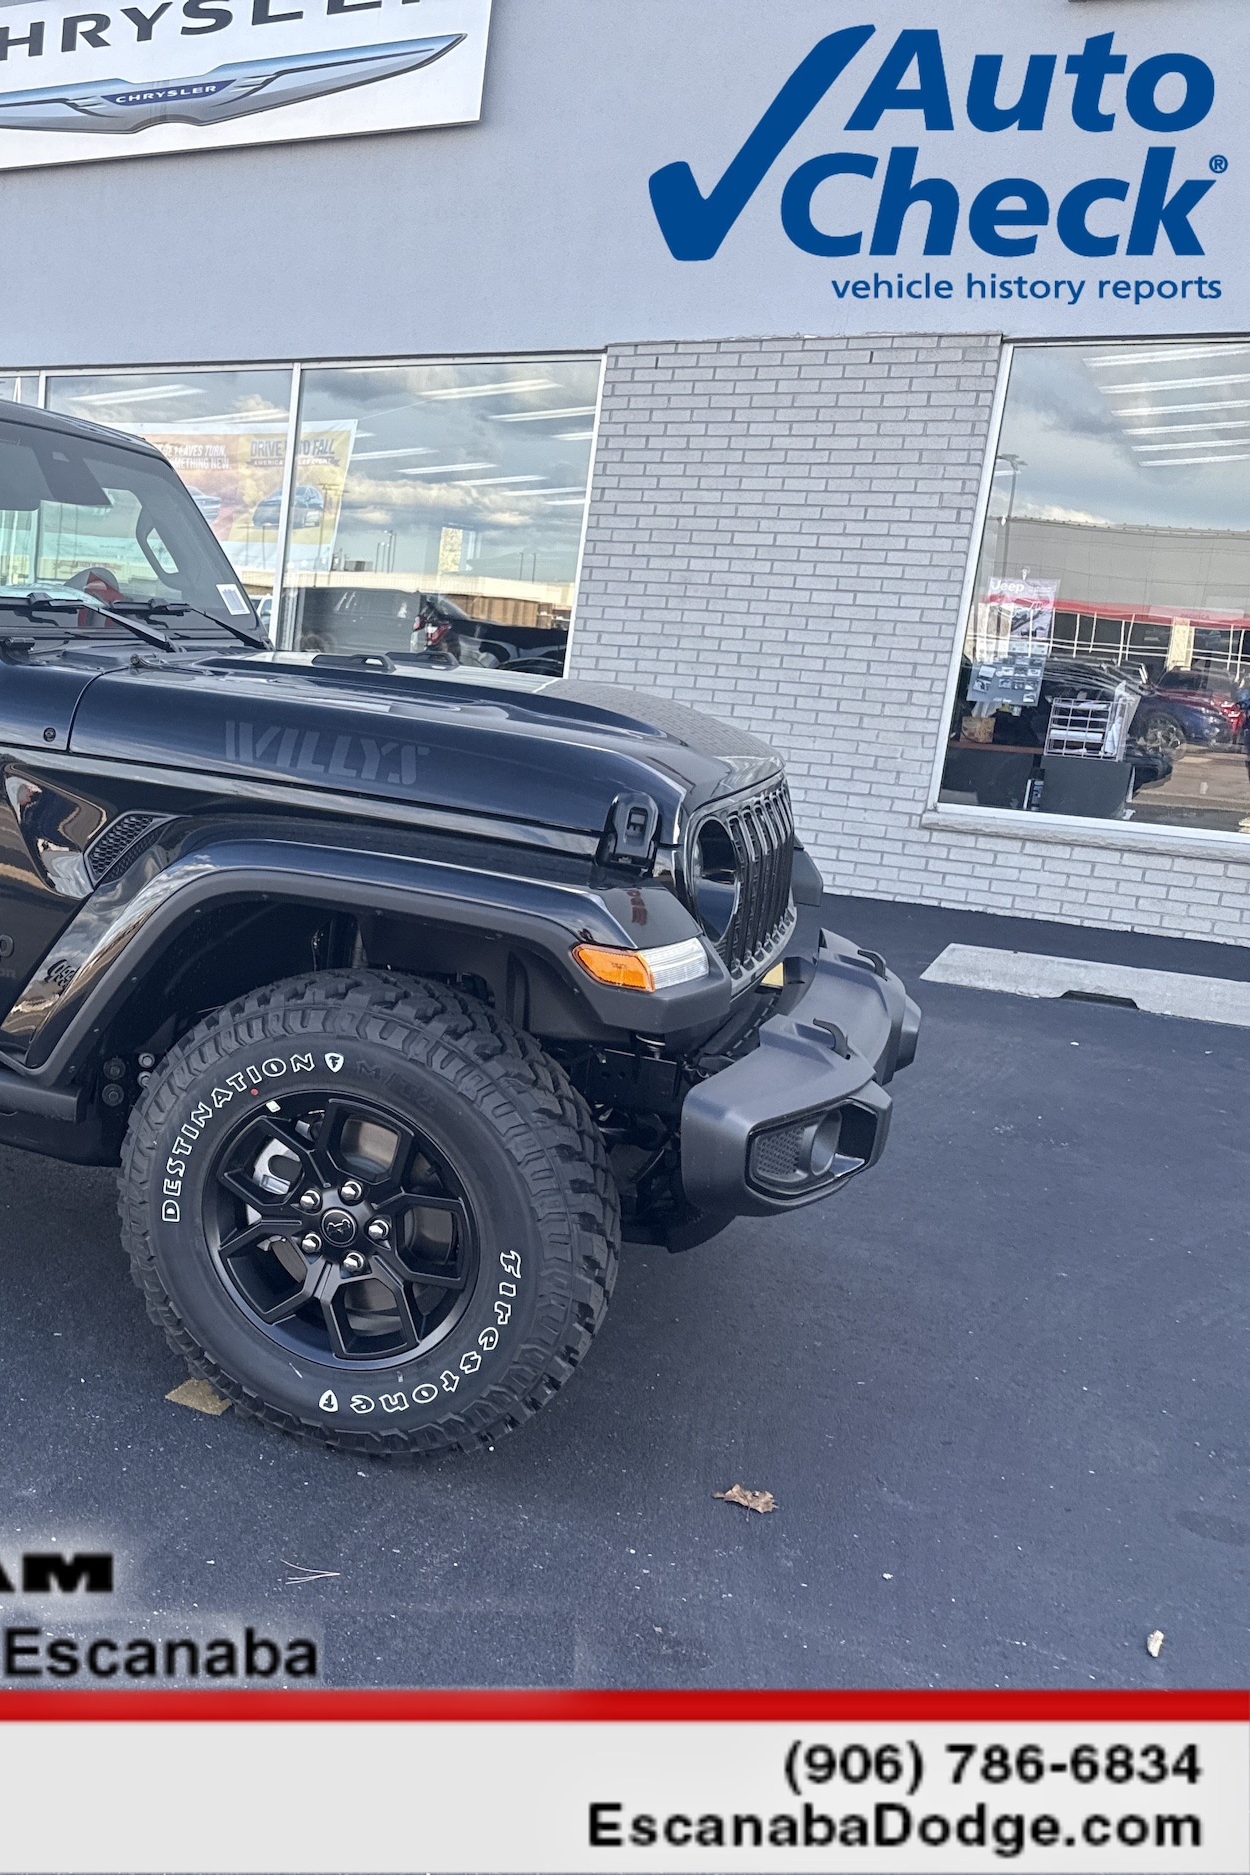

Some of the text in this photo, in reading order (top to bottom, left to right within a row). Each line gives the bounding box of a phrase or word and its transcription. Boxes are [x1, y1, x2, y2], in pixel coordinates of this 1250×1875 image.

[115, 85, 217, 103] CHRYSLER
[251, 441, 283, 457] DRIVE
[313, 438, 335, 456] FALL
[170, 457, 209, 469] METHING
[990, 580, 1025, 594] Jeep
[225, 720, 430, 785] WILLYS
[162, 1052, 315, 1223] DESTINATION
